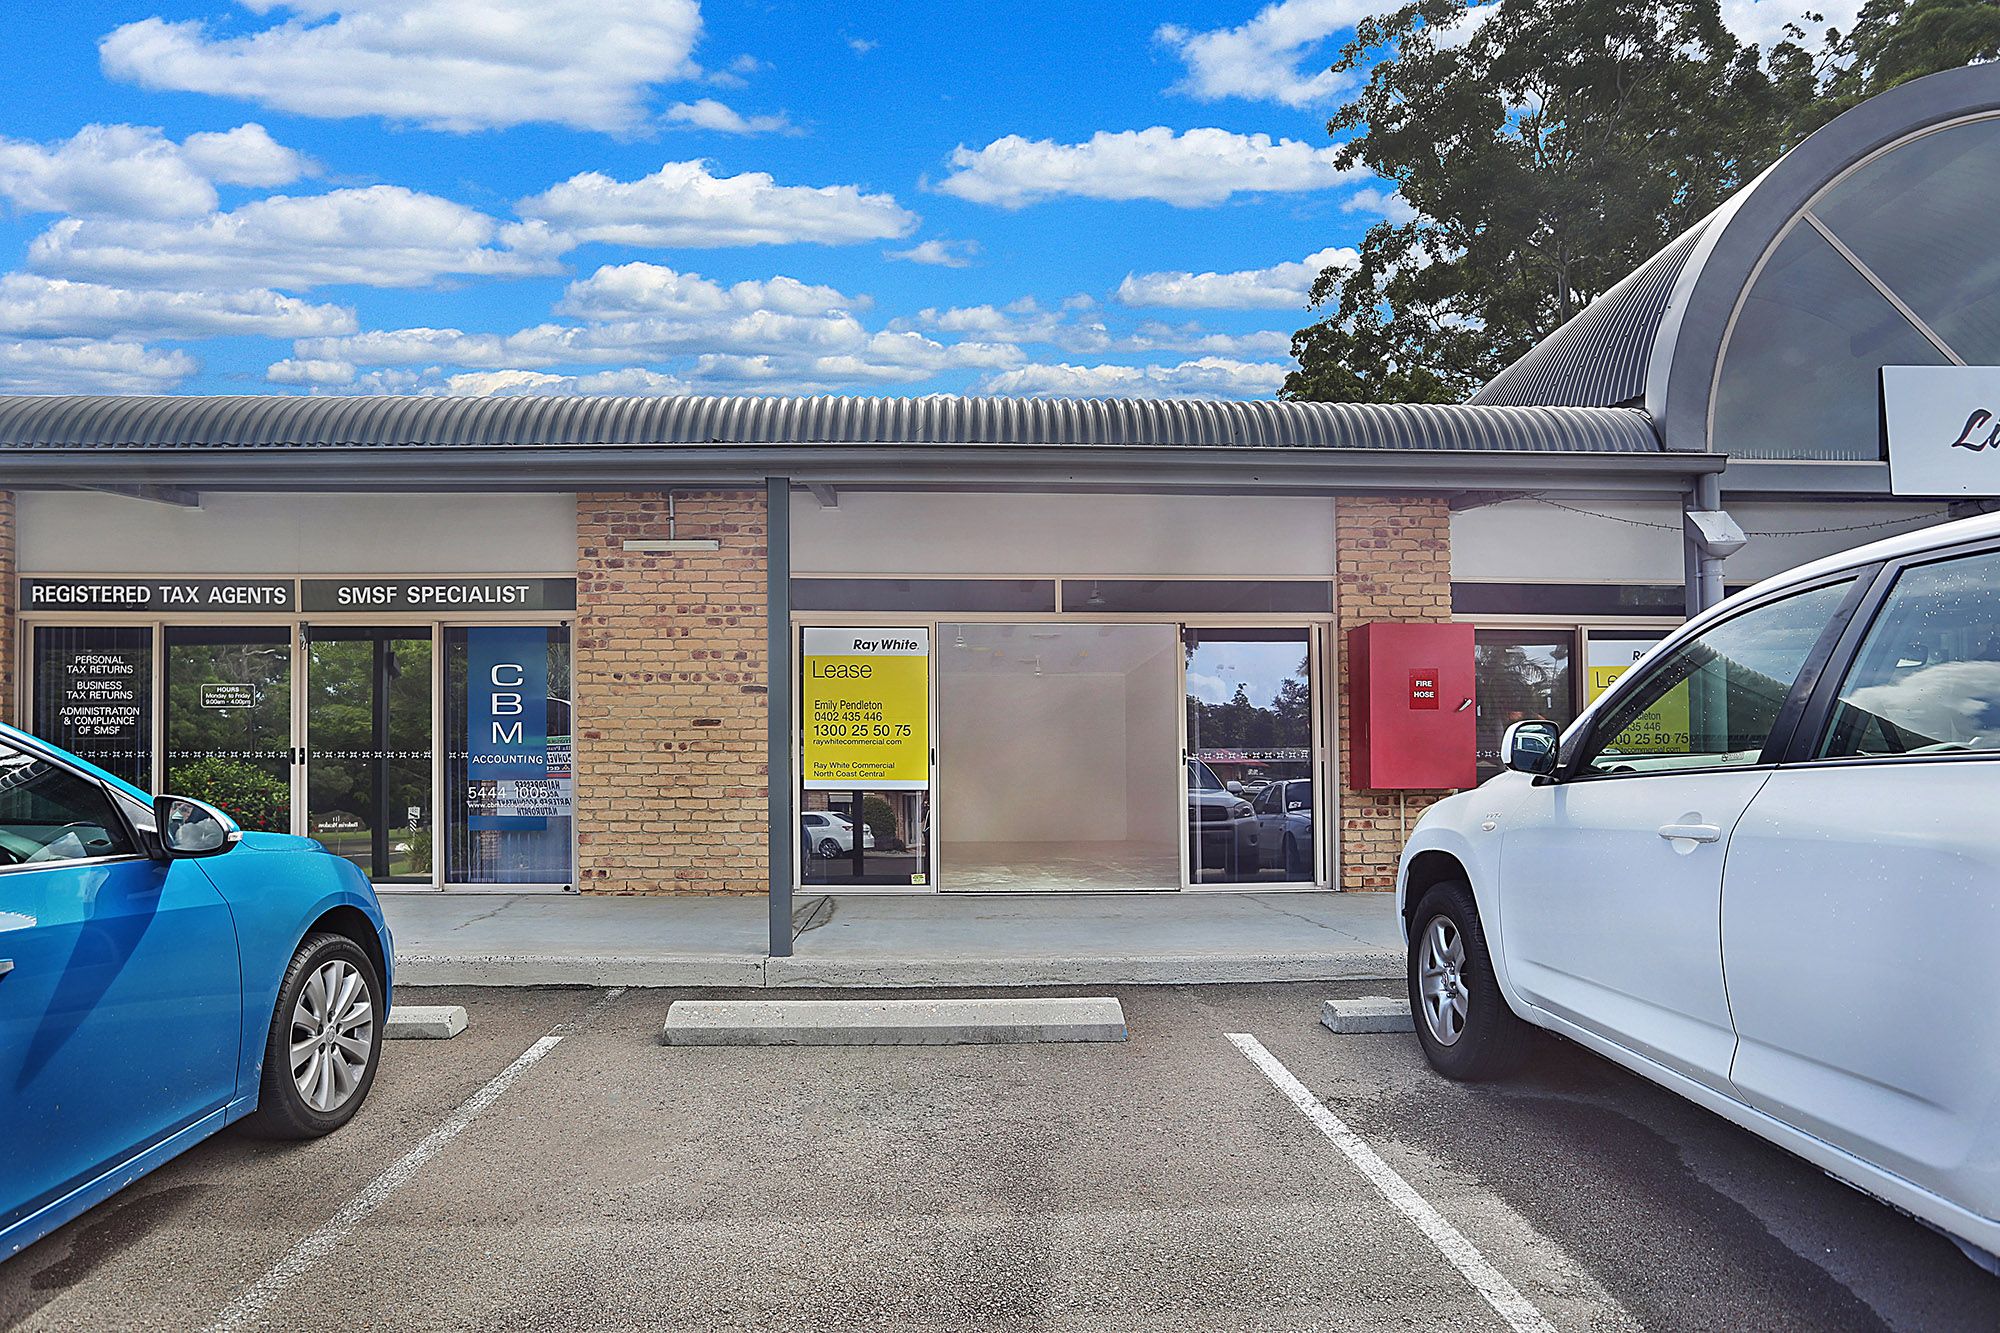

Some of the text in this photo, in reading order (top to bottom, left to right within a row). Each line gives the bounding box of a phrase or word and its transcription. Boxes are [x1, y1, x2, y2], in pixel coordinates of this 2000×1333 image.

[32, 585, 287, 605] REGISTERED TAX AGENTS
[338, 586, 530, 605] SMSF SPECIALIST
[853, 639, 917, 652] Ray White
[75, 655, 124, 664] PERSONAL
[66, 665, 134, 674] TAX RETURNS
[812, 660, 872, 678] Lease
[77, 681, 122, 690] BUSINESS
[66, 690, 133, 700] TAX RETURNS
[814, 699, 882, 711] Emily Pendleton
[59, 706, 140, 716] ADMINISTRATION
[814, 711, 882, 721] 0402 435 446
[63, 716, 135, 725] & COMPLIANCE
[78, 726, 120, 735] OF SMSF
[813, 724, 911, 736] 1300 25 50 75
[1643, 722, 1660, 731] 446
[1634, 733, 1650, 745] 25
[1654, 733, 1670, 745] 50
[1674, 732, 1689, 744] 75
[472, 754, 543, 765] ACCOUNTING
[813, 762, 827, 770] Ray
[468, 786, 507, 799] 5444
[514, 786, 548, 799] 1005
